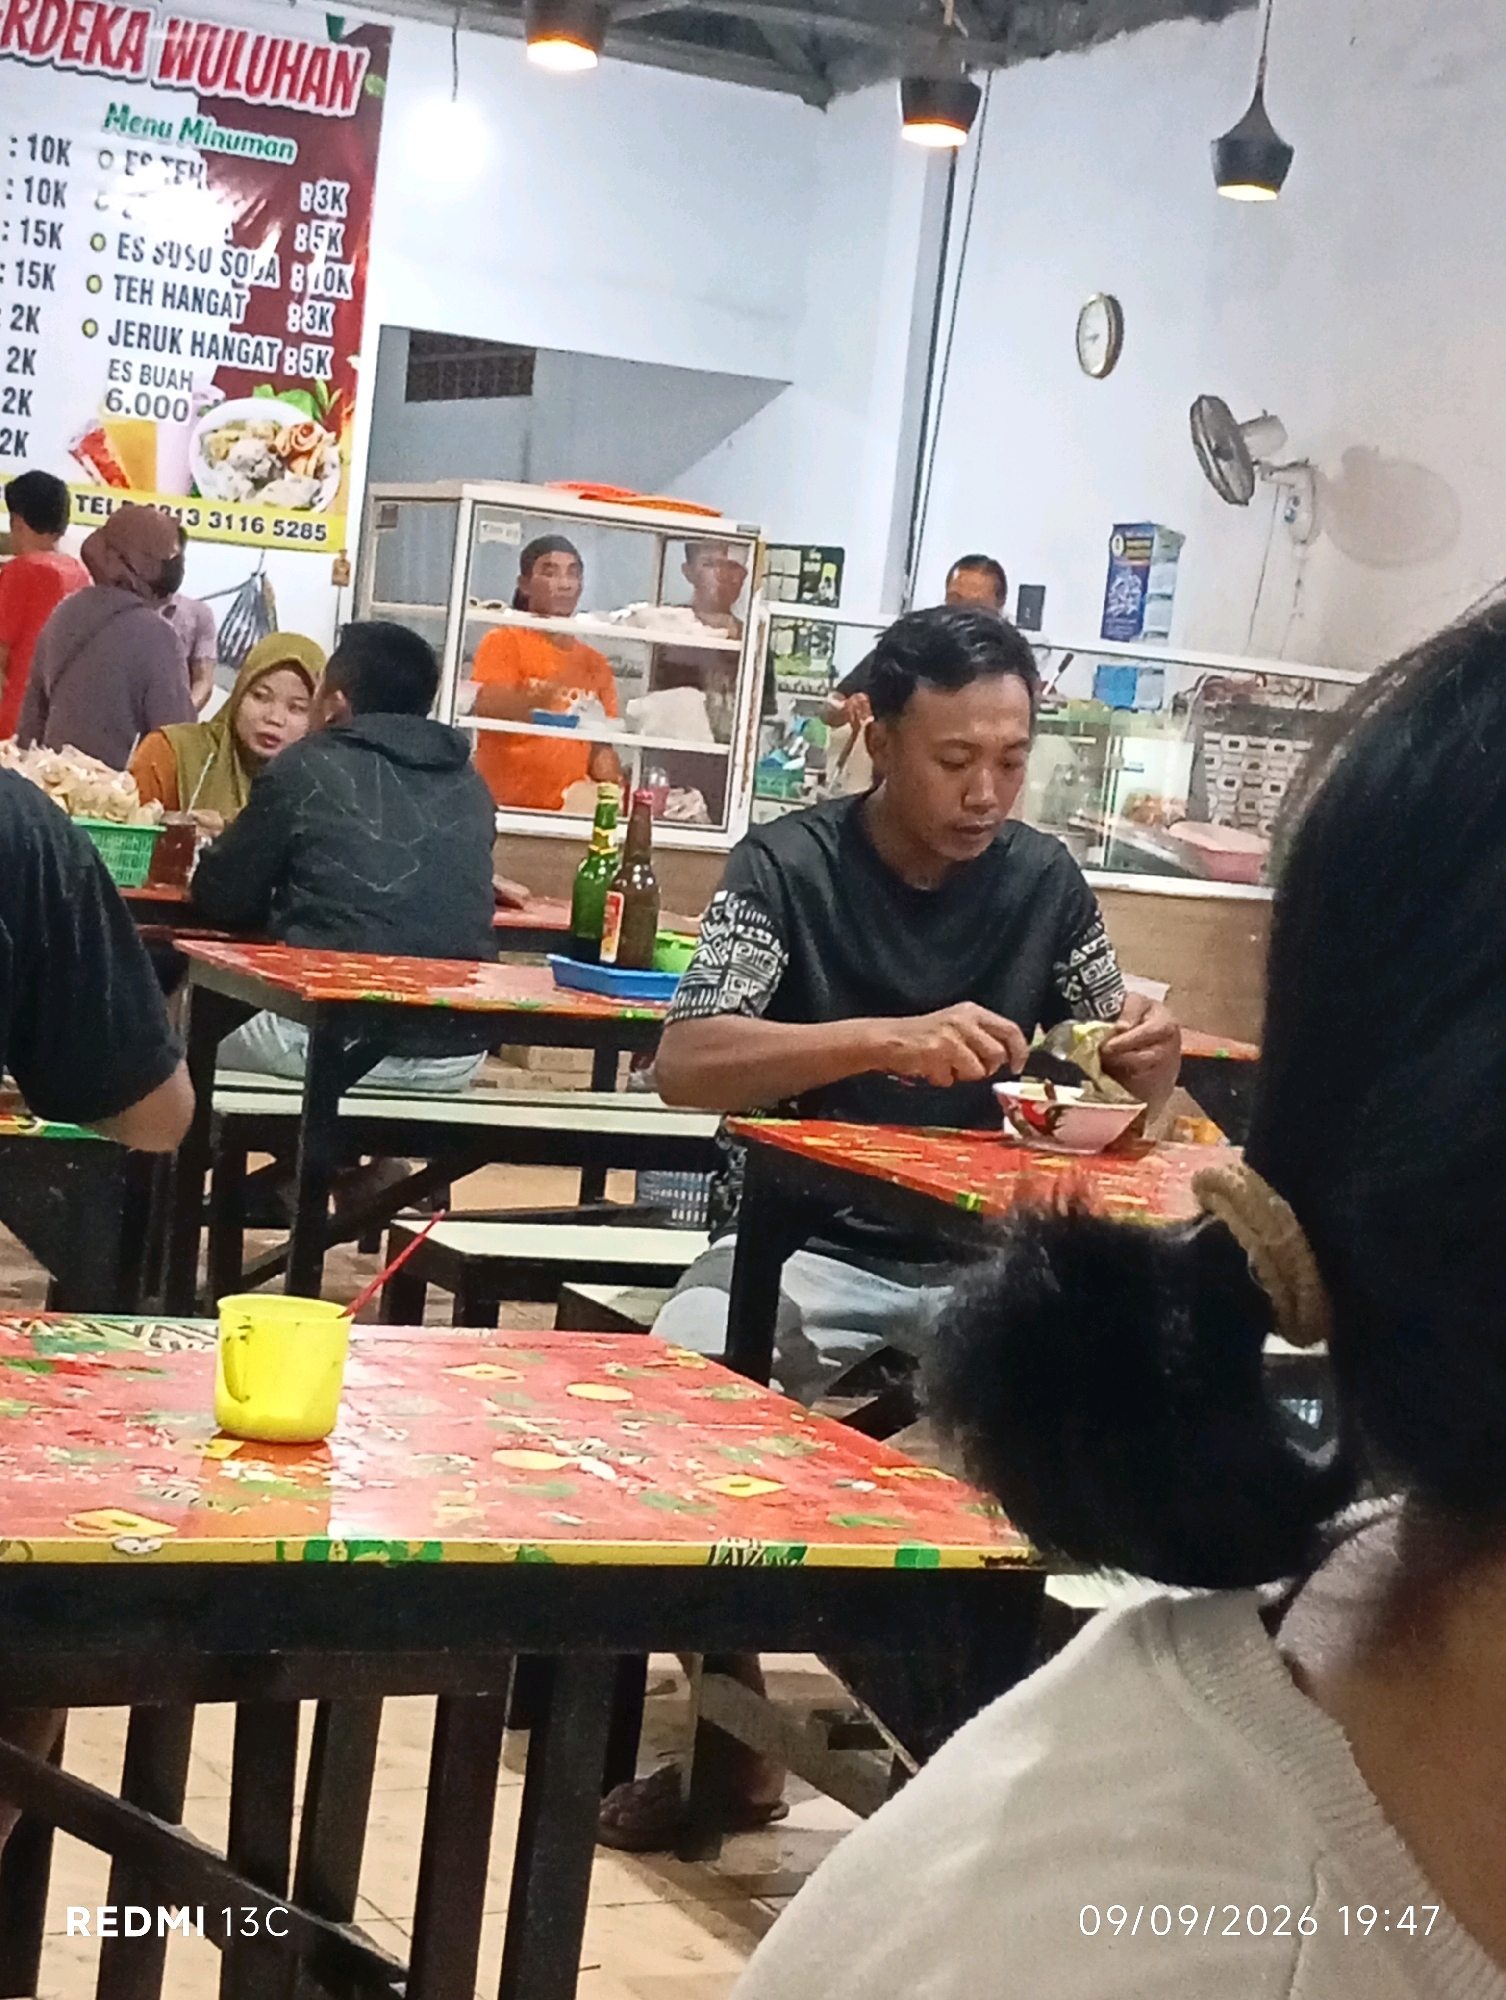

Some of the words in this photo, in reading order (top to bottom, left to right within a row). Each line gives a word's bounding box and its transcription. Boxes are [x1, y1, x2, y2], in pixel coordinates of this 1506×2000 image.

[0, 0, 150, 73] RDEKA
[159, 18, 366, 111] WULUHAN
[104, 102, 173, 138] Menu
[179, 116, 295, 160] Minuman
[27, 133, 73, 167] 10K
[24, 175, 68, 209] 10K
[317, 184, 345, 212] 3K
[20, 216, 65, 250] 15K
[117, 231, 146, 263] ES
[15, 258, 57, 292] 15K
[10, 304, 41, 334] 2K
[114, 274, 154, 306] TEH
[161, 282, 247, 319] HANGAT
[305, 304, 331, 333] 3K
[6, 346, 37, 376] 2K
[108, 319, 184, 355] JERUK
[190, 330, 278, 367] HANGAT
[302, 347, 330, 375] 5K
[108, 358, 133, 383] ES
[139, 362, 194, 392] BUAH
[2, 387, 34, 417] 2K
[105, 388, 189, 422] 6.000
[0, 428, 29, 458] 2K
[75, 493, 134, 515] TEL
[208, 511, 265, 534] 3116
[273, 520, 327, 542] 5285
